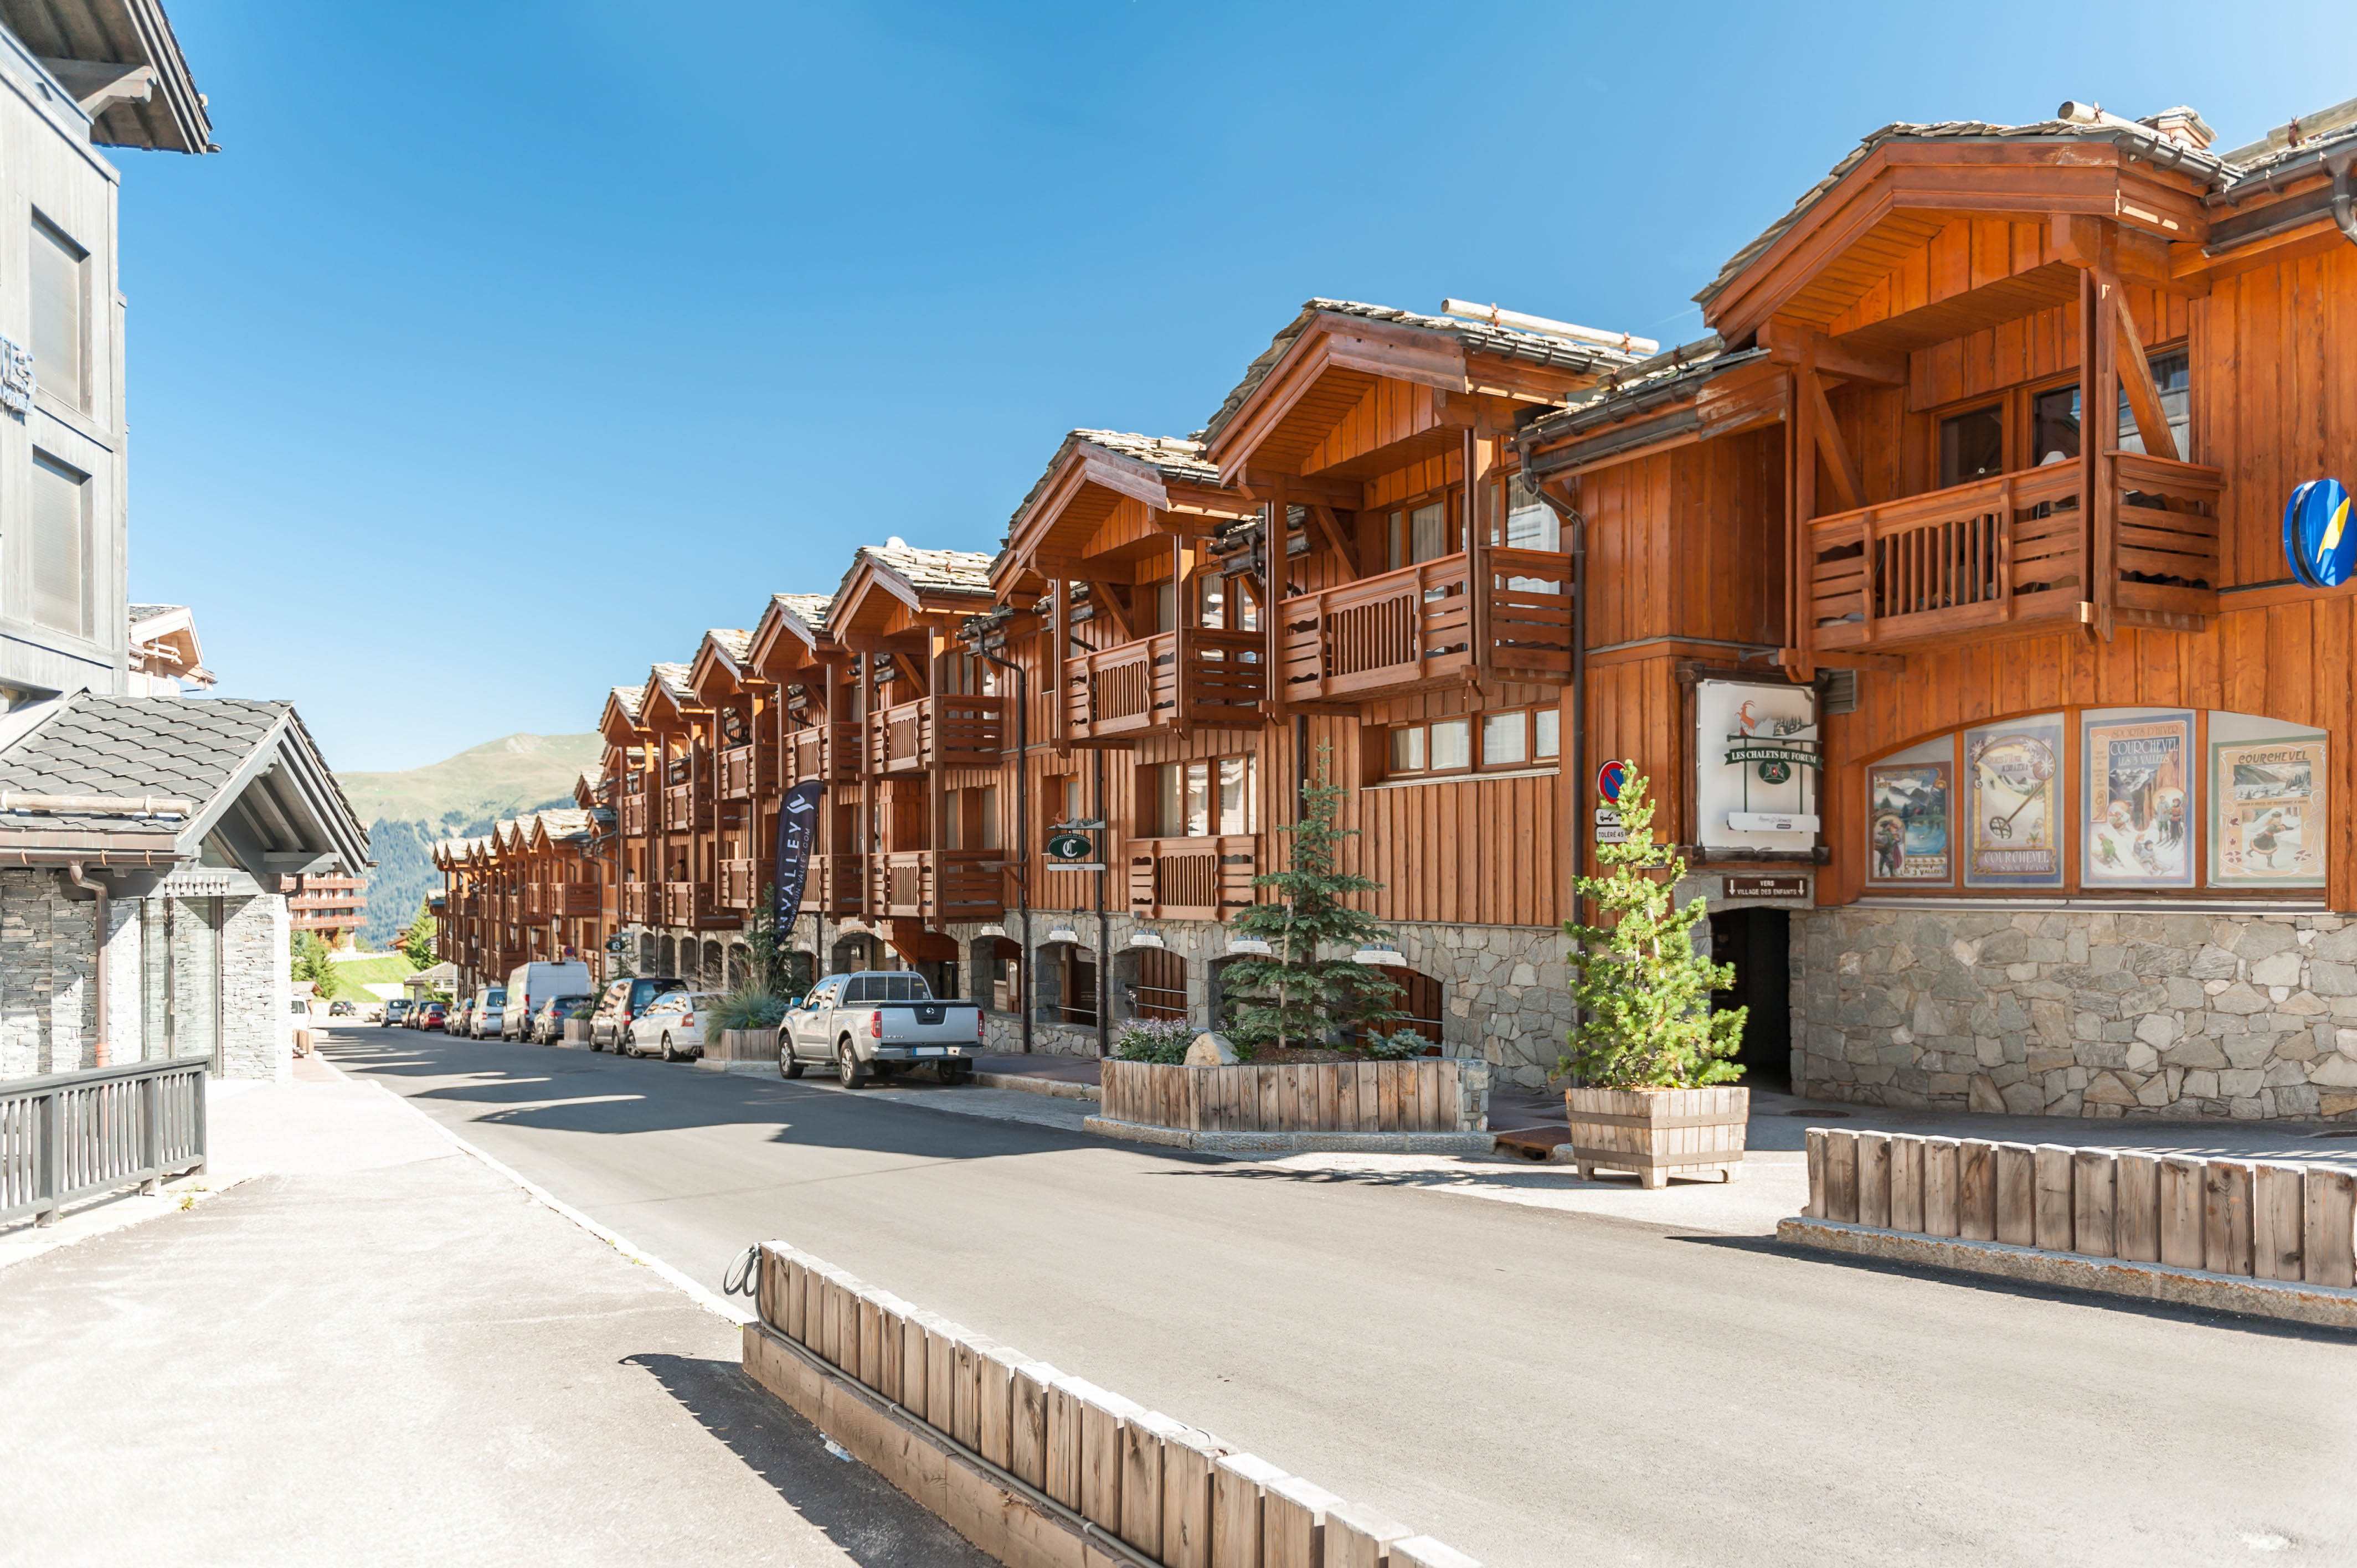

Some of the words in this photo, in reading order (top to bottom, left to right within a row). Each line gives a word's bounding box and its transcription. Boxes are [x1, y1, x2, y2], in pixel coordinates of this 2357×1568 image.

[2113, 728, 2145, 736] SPORTS
[2110, 738, 2179, 756] COURCHEVEL
[1731, 751, 1746, 760] LES
[1746, 750, 1779, 759] CHALETS
[1780, 751, 1791, 759] DU
[1791, 752, 1817, 763] FORUM
[2238, 751, 2308, 764] COURCHEVEL
[1063, 839, 1078, 857] C
[1984, 850, 2049, 863] COURCHEVEL
